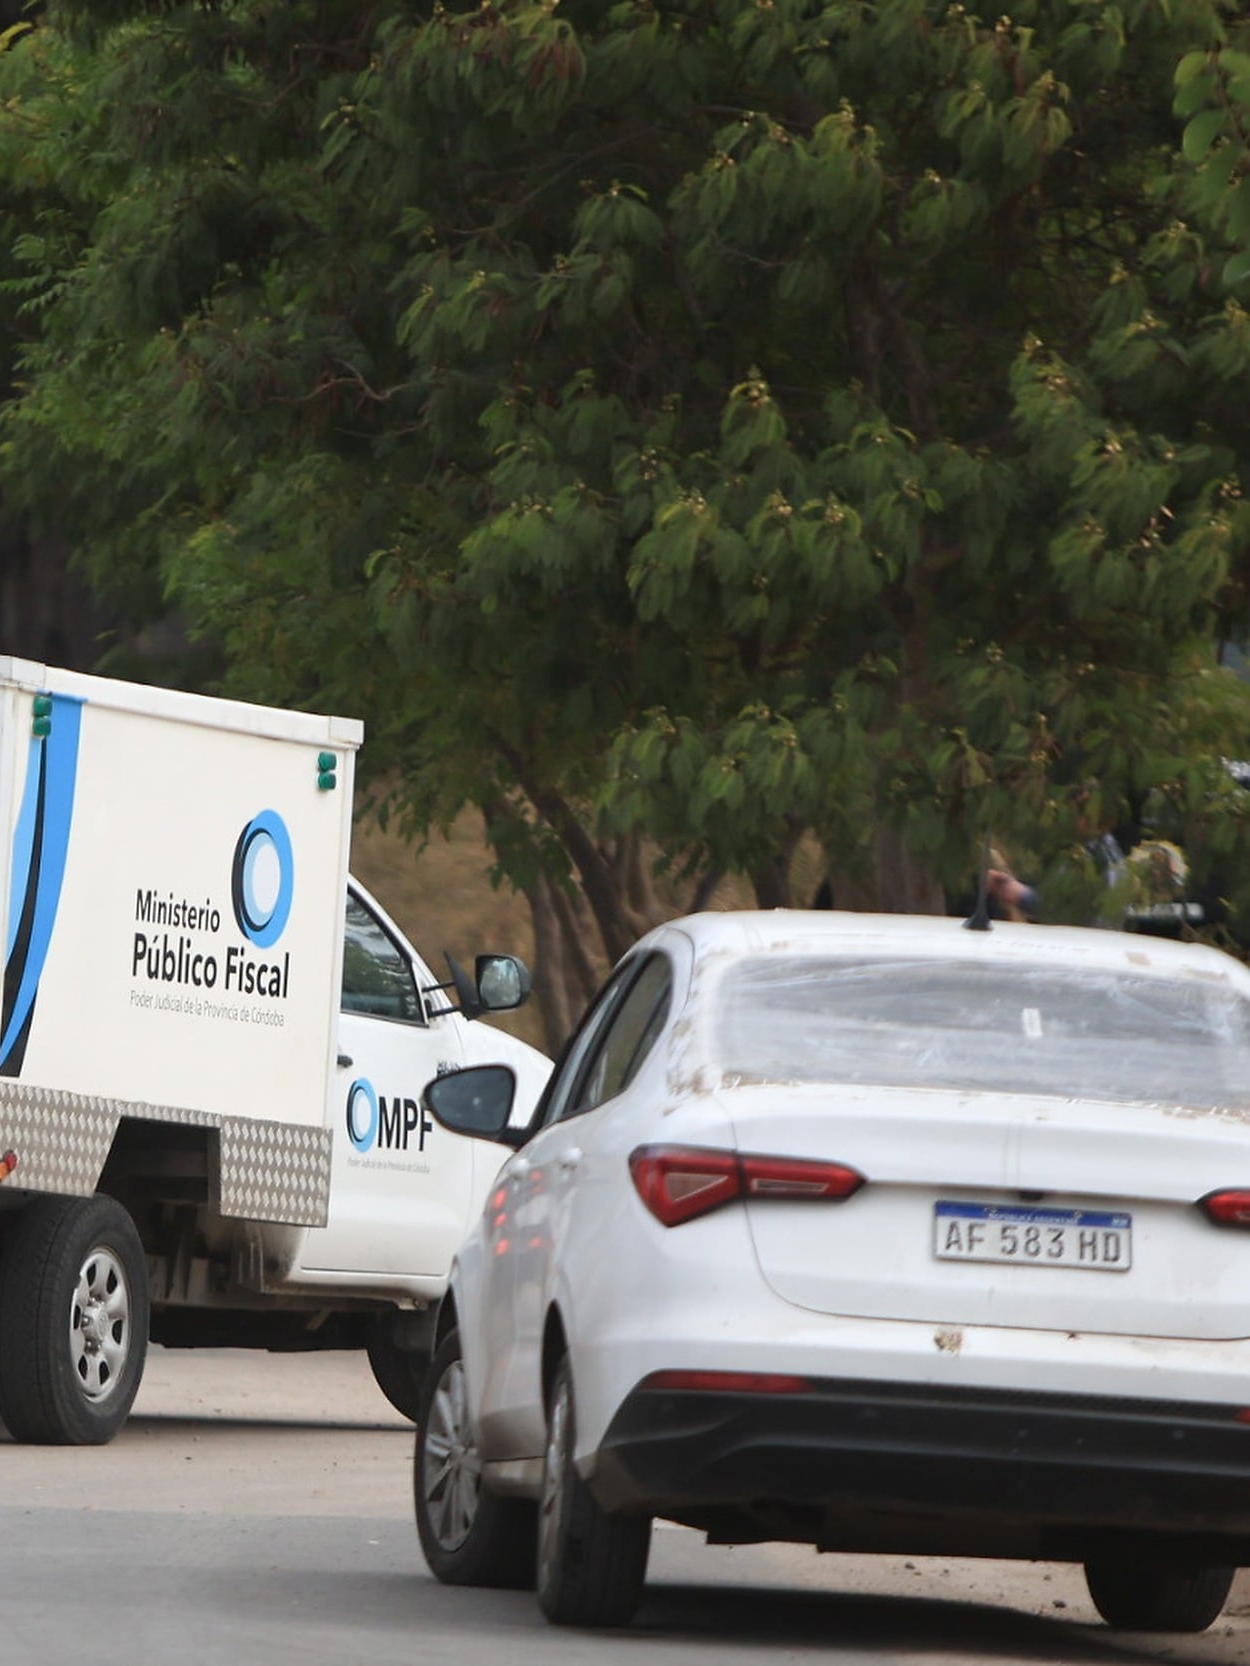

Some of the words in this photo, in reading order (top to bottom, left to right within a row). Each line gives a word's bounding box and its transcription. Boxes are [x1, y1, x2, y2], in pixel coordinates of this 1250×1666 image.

[135, 889, 221, 933] Ministerio
[132, 932, 218, 988] Público
[225, 946, 290, 999] Fiscal
[130, 989, 153, 1009] Poder
[154, 994, 183, 1013] Judicial
[184, 997, 194, 1014] de
[195, 997, 203, 1015] la
[204, 1000, 239, 1020] Provincia
[240, 1005, 250, 1022] de
[378, 1096, 432, 1152] MPF
[945, 1220, 986, 1252] AF
[1000, 1225, 1066, 1259] 583
[1078, 1230, 1121, 1263] HD
